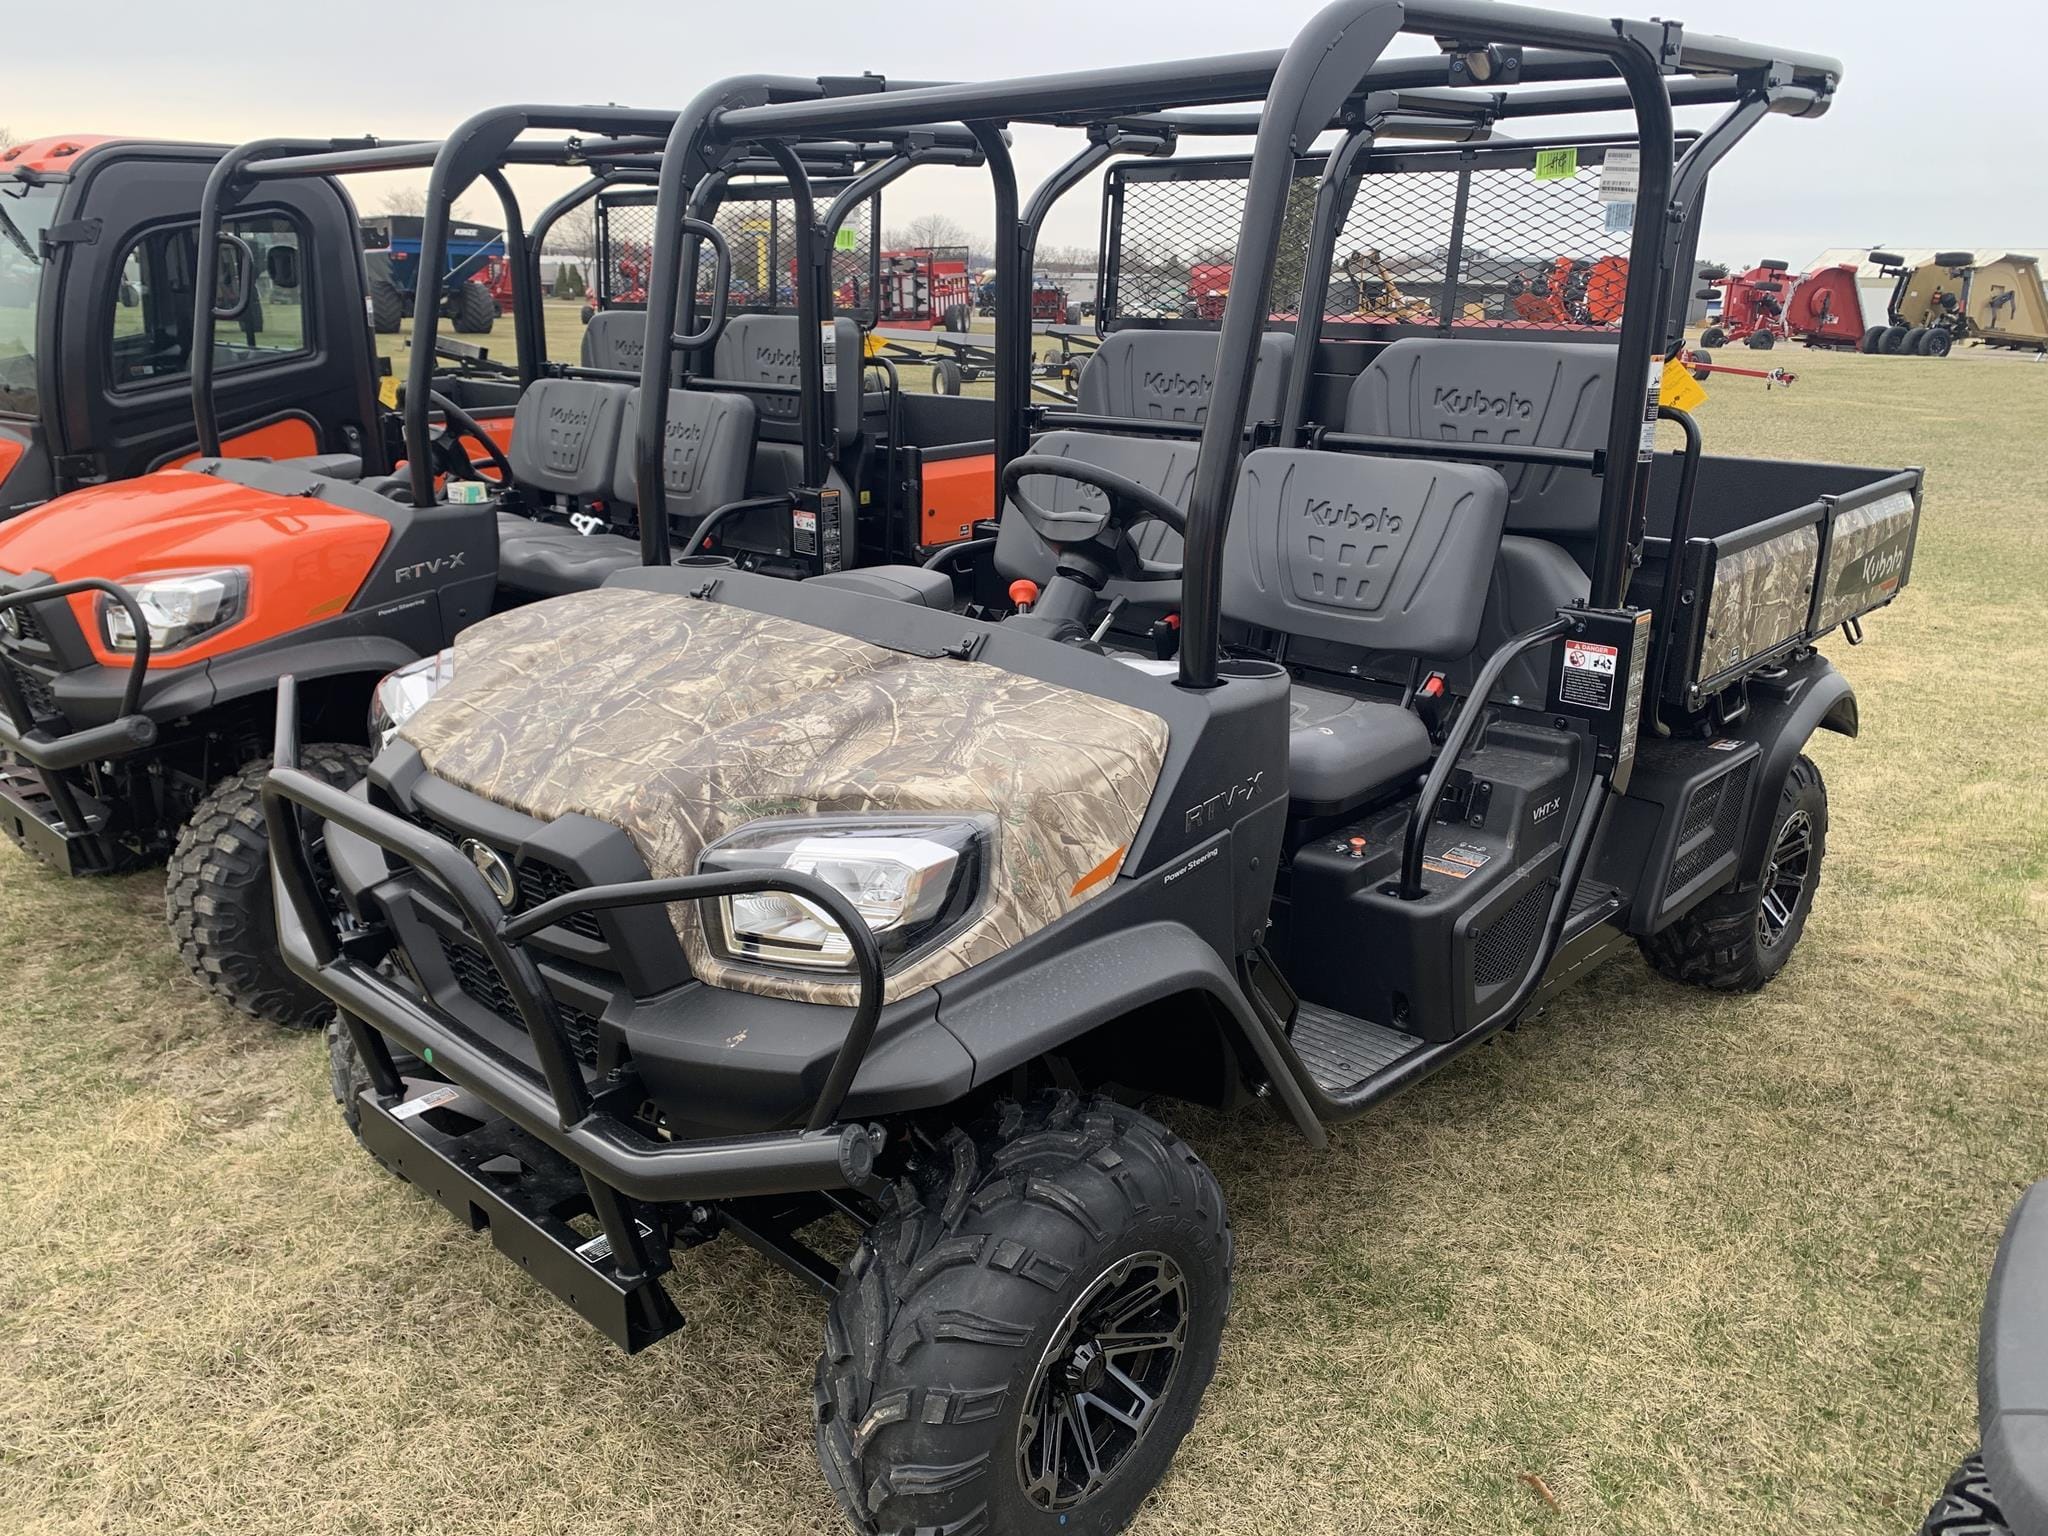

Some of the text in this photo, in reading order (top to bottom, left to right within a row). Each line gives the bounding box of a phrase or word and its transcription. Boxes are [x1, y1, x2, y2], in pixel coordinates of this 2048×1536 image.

[549, 406, 588, 427] Kubota
[1434, 388, 1533, 419] Kubota
[666, 420, 701, 442] ubota
[1303, 498, 1402, 535] Kubota
[395, 551, 465, 584] RTV-X
[1862, 544, 1903, 584] Kubota
[1581, 645, 1608, 653] DANGER
[1185, 771, 1264, 833] RTV-X
[1532, 797, 1561, 821] VHT-X
[1164, 848, 1219, 884] Power Steering
